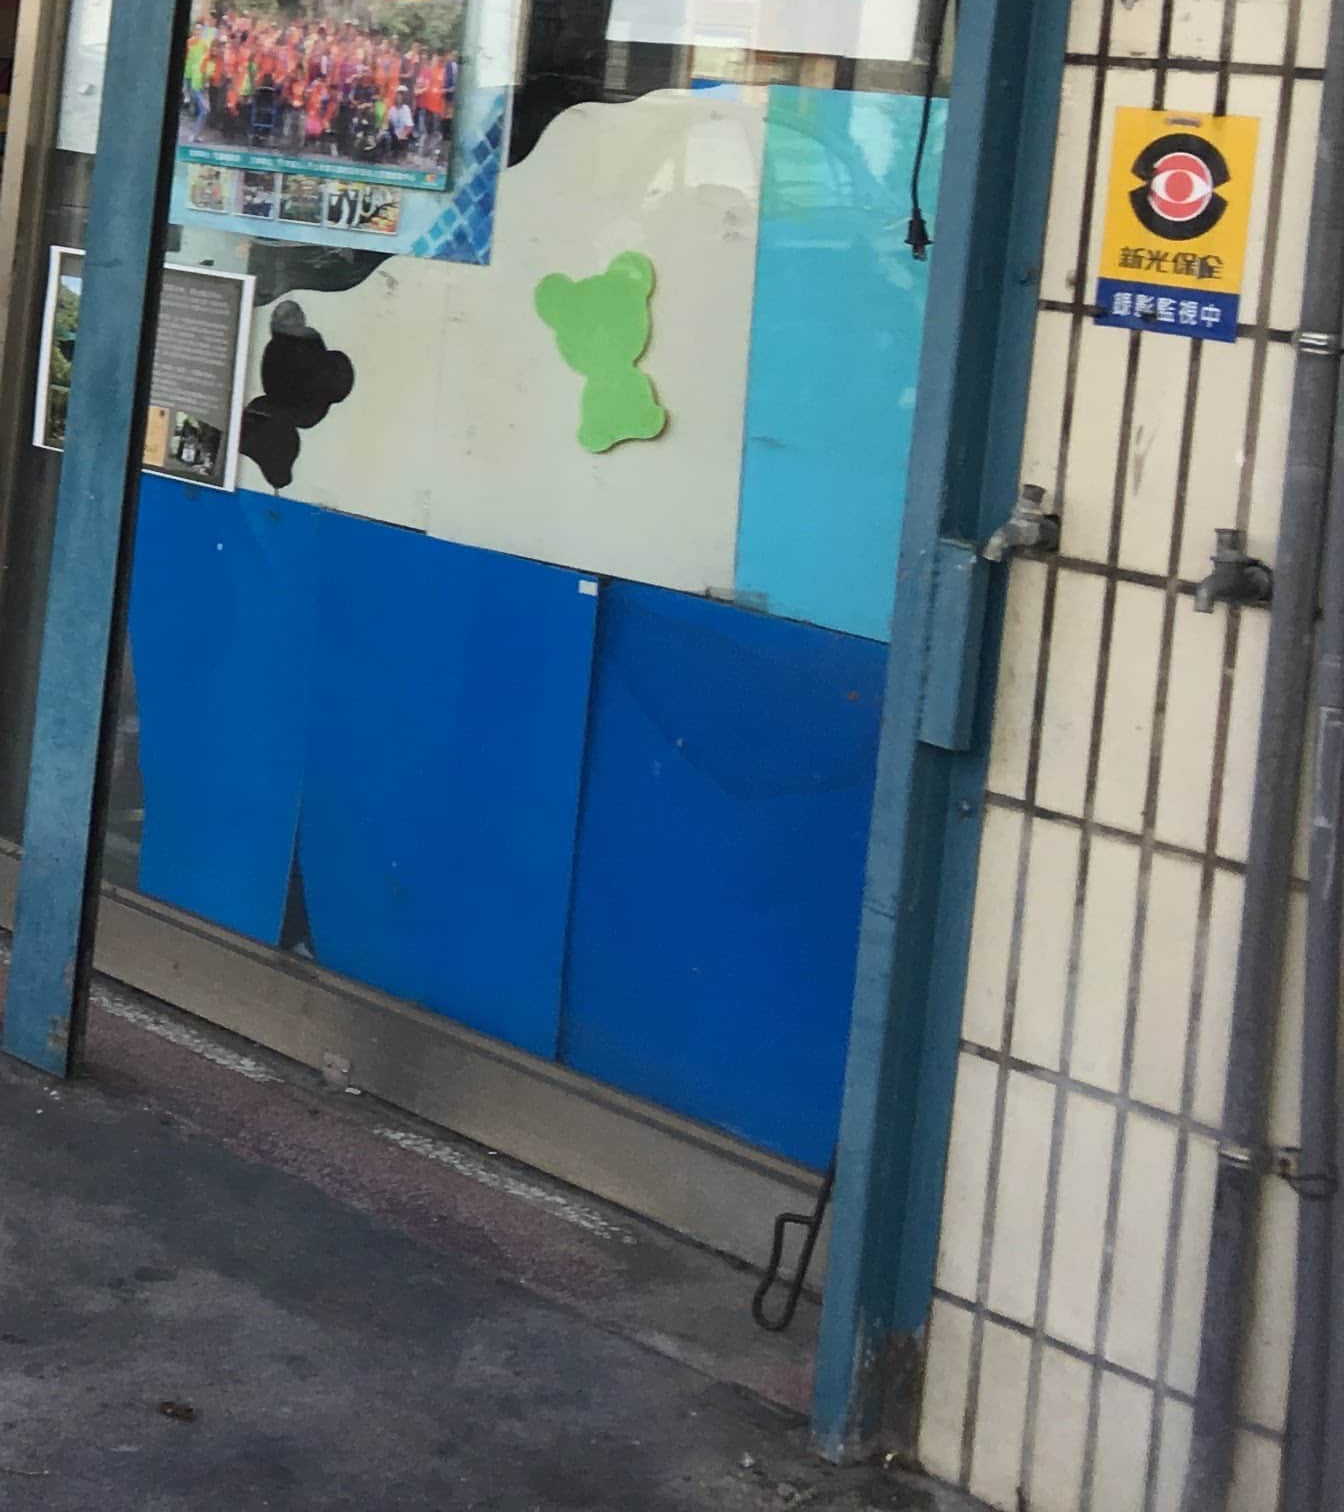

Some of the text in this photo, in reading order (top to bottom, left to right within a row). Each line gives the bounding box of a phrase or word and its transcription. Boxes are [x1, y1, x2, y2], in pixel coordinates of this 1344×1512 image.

[1118, 245, 1224, 280] 新光保全
[1112, 292, 1222, 328] 錄影監視中
